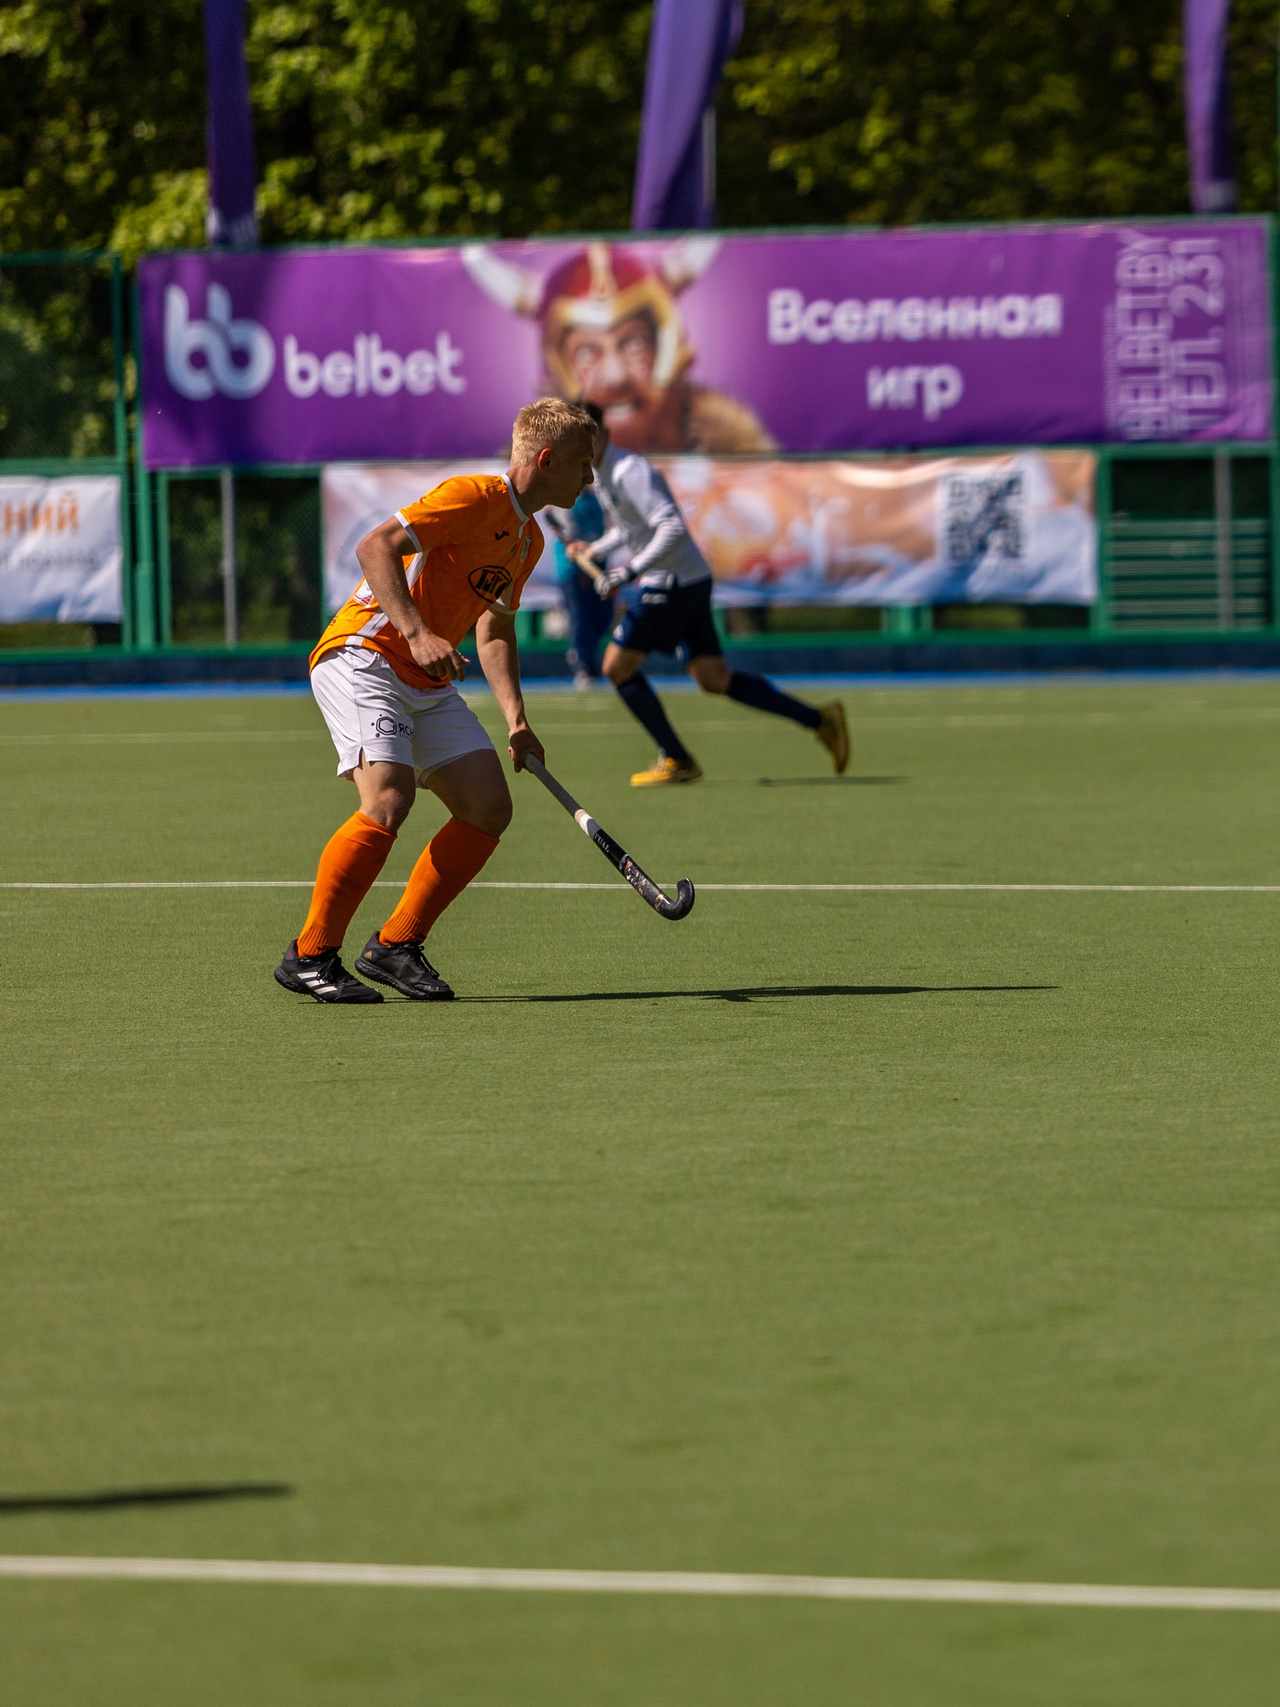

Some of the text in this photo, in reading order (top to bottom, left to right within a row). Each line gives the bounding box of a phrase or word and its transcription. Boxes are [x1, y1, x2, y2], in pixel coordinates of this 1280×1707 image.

[767, 288, 1064, 345] Вселенная
[285, 331, 467, 398] belbet
[867, 363, 965, 421] игр
